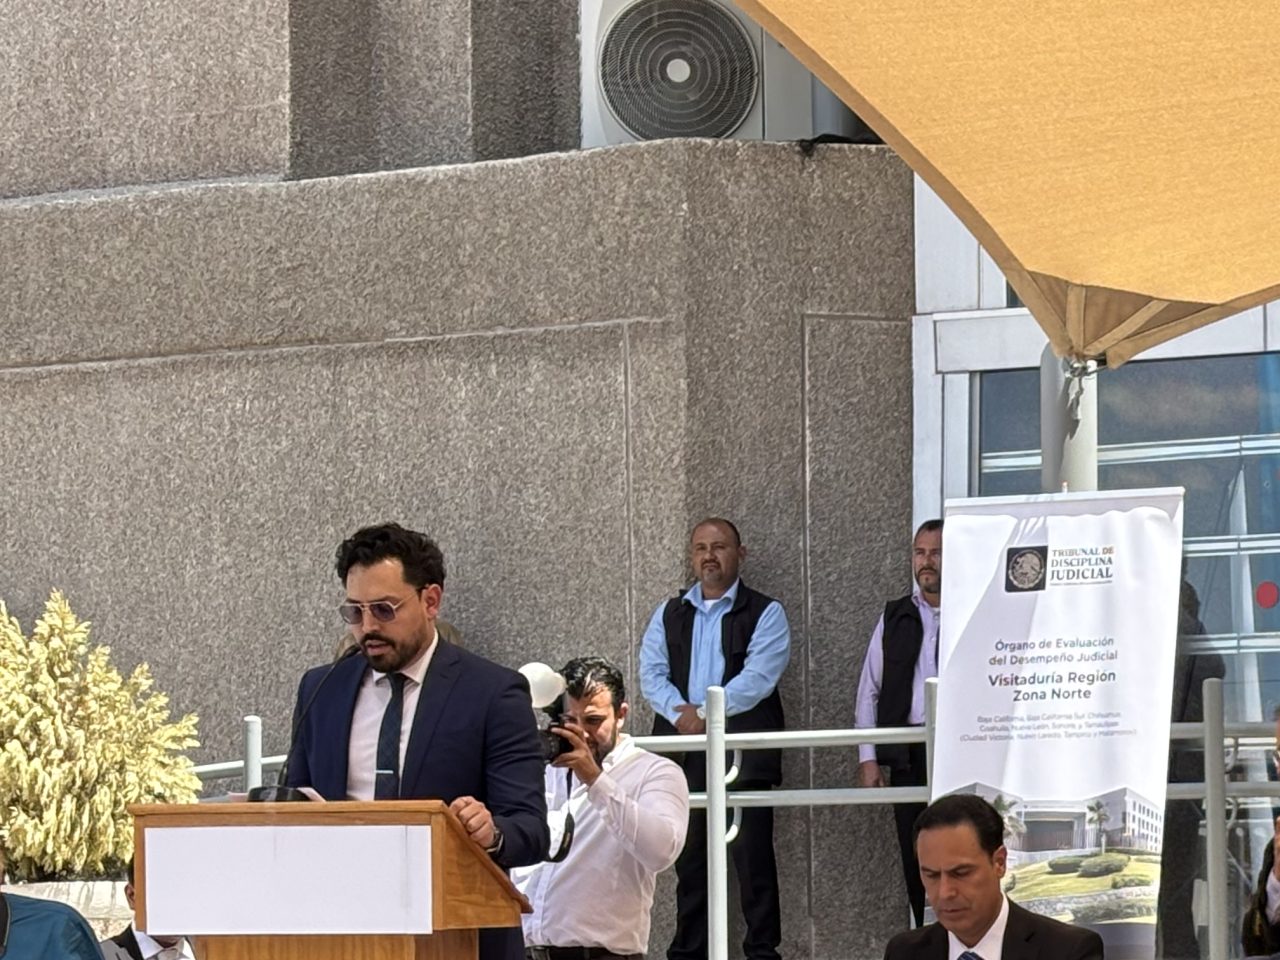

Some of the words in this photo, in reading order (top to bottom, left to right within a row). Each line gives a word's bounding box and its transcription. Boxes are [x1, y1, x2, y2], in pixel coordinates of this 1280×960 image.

[1052, 547, 1100, 557] TRIBUNAL
[1102, 546, 1114, 555] DE
[1051, 556, 1113, 568] DISCIPLINA
[1050, 567, 1113, 581] JUDICIAL
[995, 639, 1036, 653] Órgano
[1038, 639, 1052, 649] de
[1055, 637, 1114, 649] Evaluación
[988, 655, 1007, 666] del
[1010, 652, 1074, 665] Desempeño
[1077, 650, 1118, 662] Judicial
[988, 671, 1063, 687] Visitaduría
[1068, 670, 1116, 685] Región
[1013, 690, 1047, 702] Zona
[1051, 688, 1092, 699] Norte
